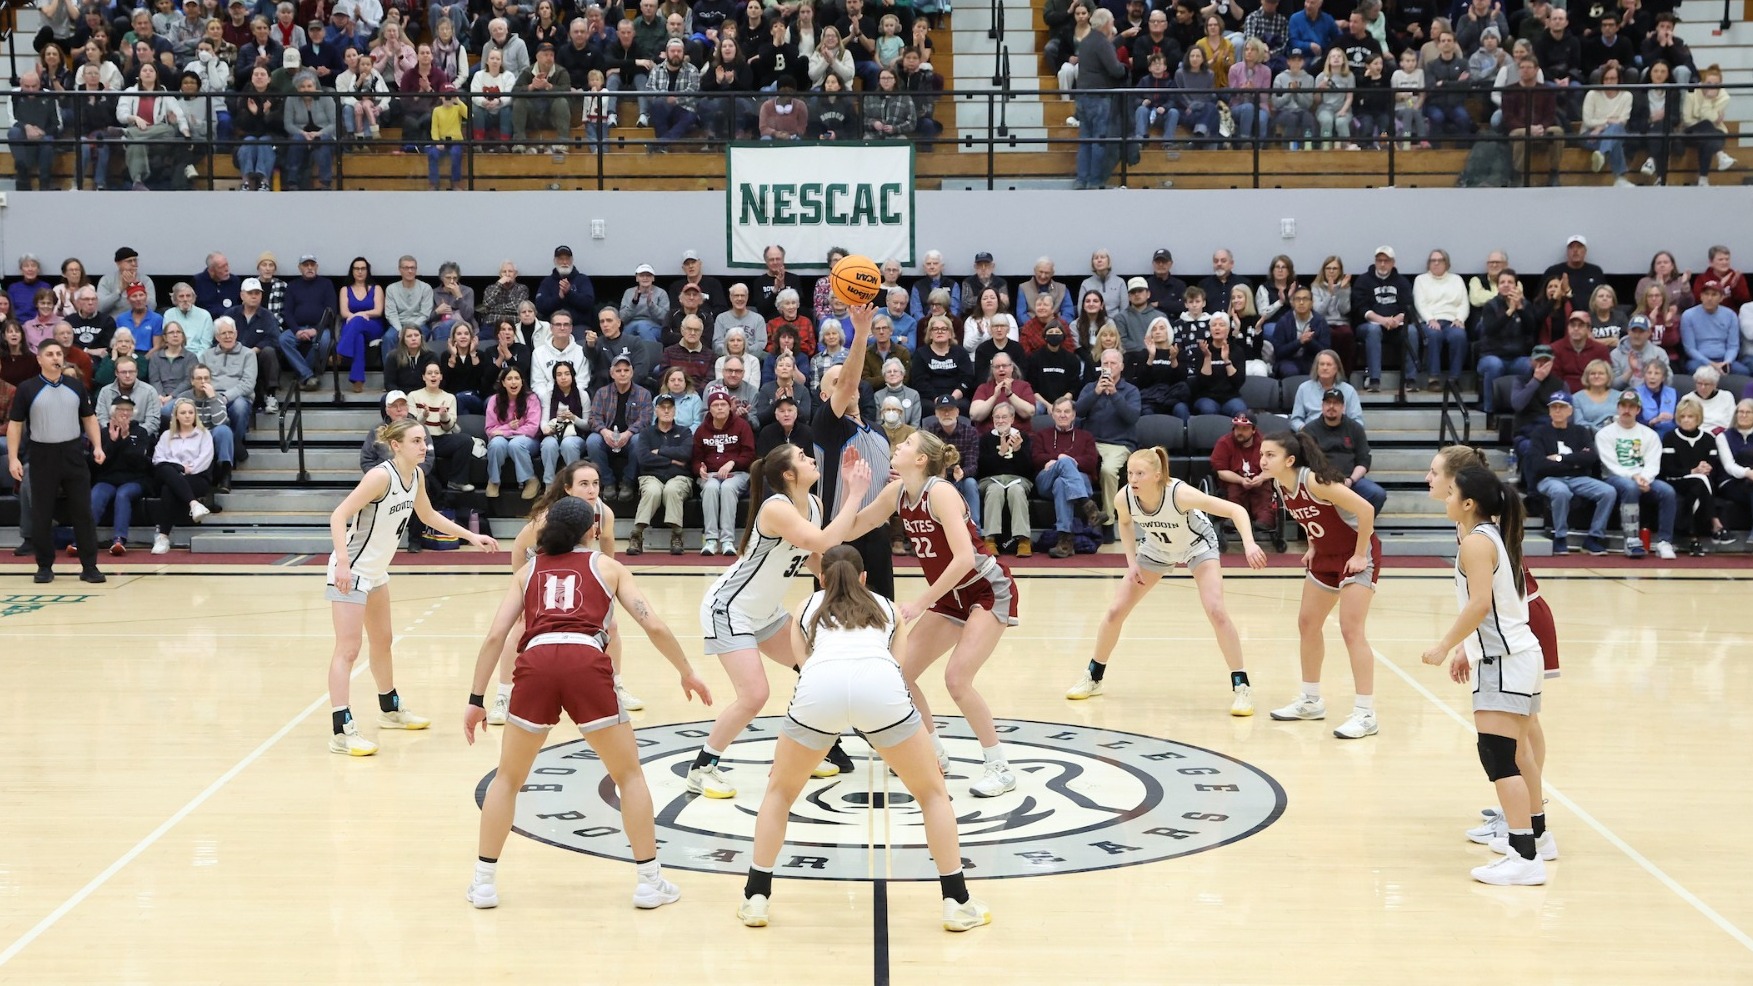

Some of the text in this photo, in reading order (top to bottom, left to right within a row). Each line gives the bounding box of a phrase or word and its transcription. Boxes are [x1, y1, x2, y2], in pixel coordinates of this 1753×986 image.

[774, 53, 785, 71] B
[739, 182, 902, 226] NESCAC
[856, 272, 879, 285] NCAA
[389, 500, 414, 515] BOWDO
[1289, 505, 1321, 519] ATES
[396, 517, 408, 540] 4
[1140, 521, 1180, 529] OWDOIN
[1308, 521, 1325, 540] 0
[910, 536, 938, 558] 22
[544, 574, 576, 611] 11
[535, 810, 830, 870] POAR
